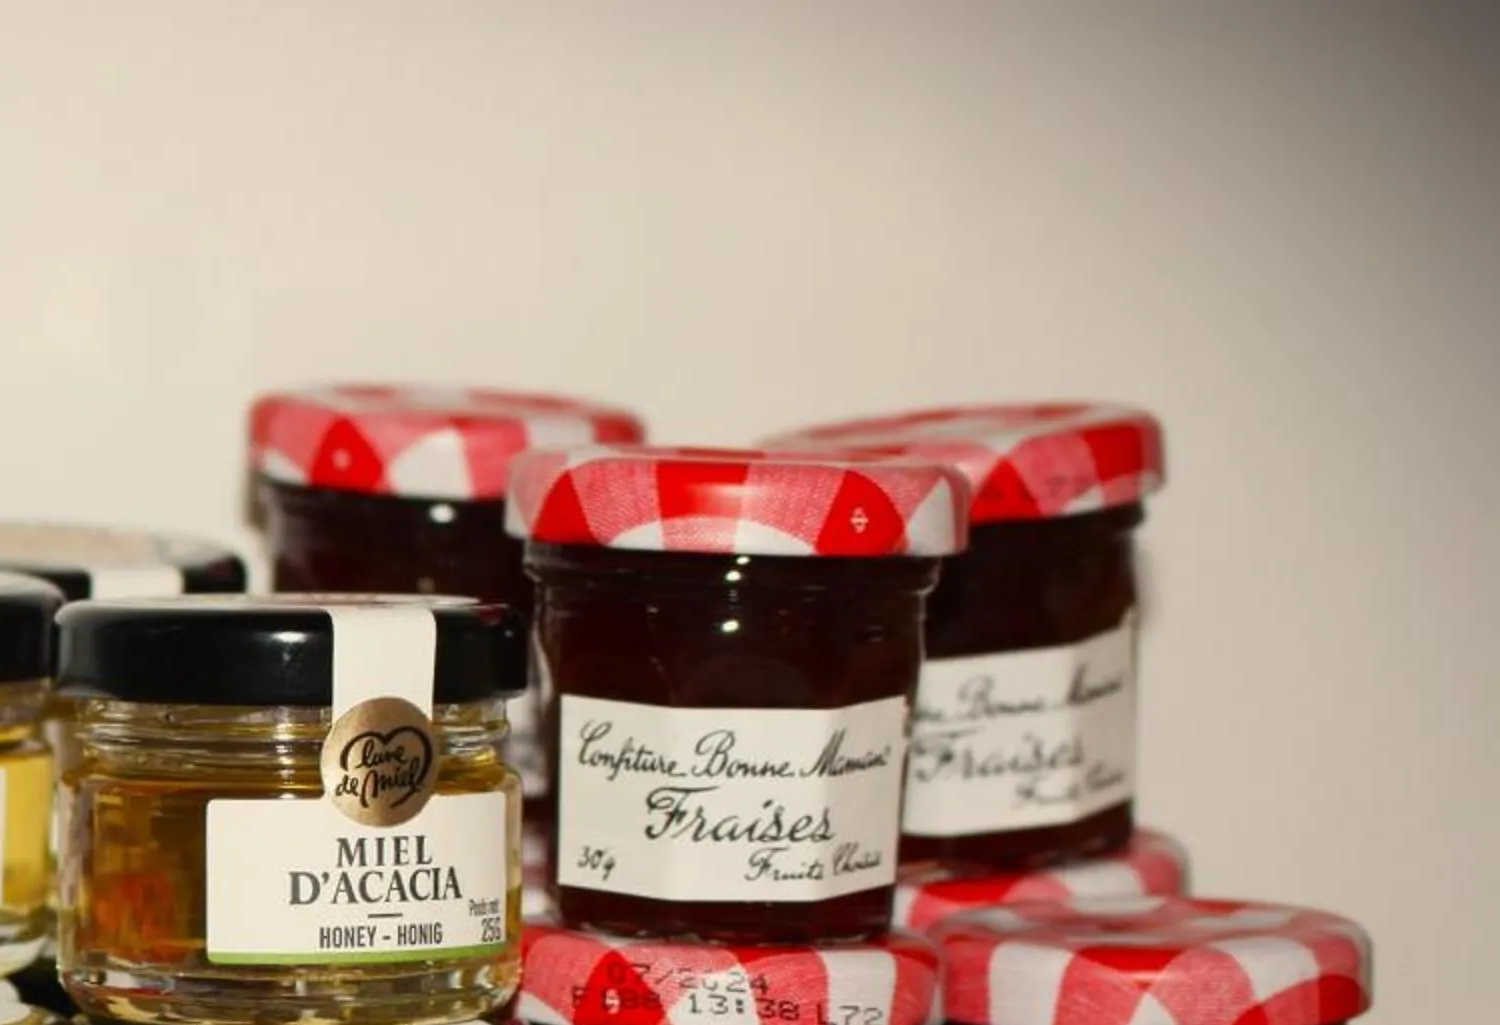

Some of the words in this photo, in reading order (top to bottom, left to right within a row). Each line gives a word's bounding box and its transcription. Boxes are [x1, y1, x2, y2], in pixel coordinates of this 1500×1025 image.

[578, 720, 687, 781] Confiture
[692, 729, 795, 778] Bonne
[646, 785, 834, 843] Fraises
[336, 834, 432, 868] MIEL
[288, 865, 463, 906] D'ACACIA
[319, 926, 377, 949] HONEY
[397, 921, 443, 946] HONIG
[687, 993, 800, 1021] 13:38
